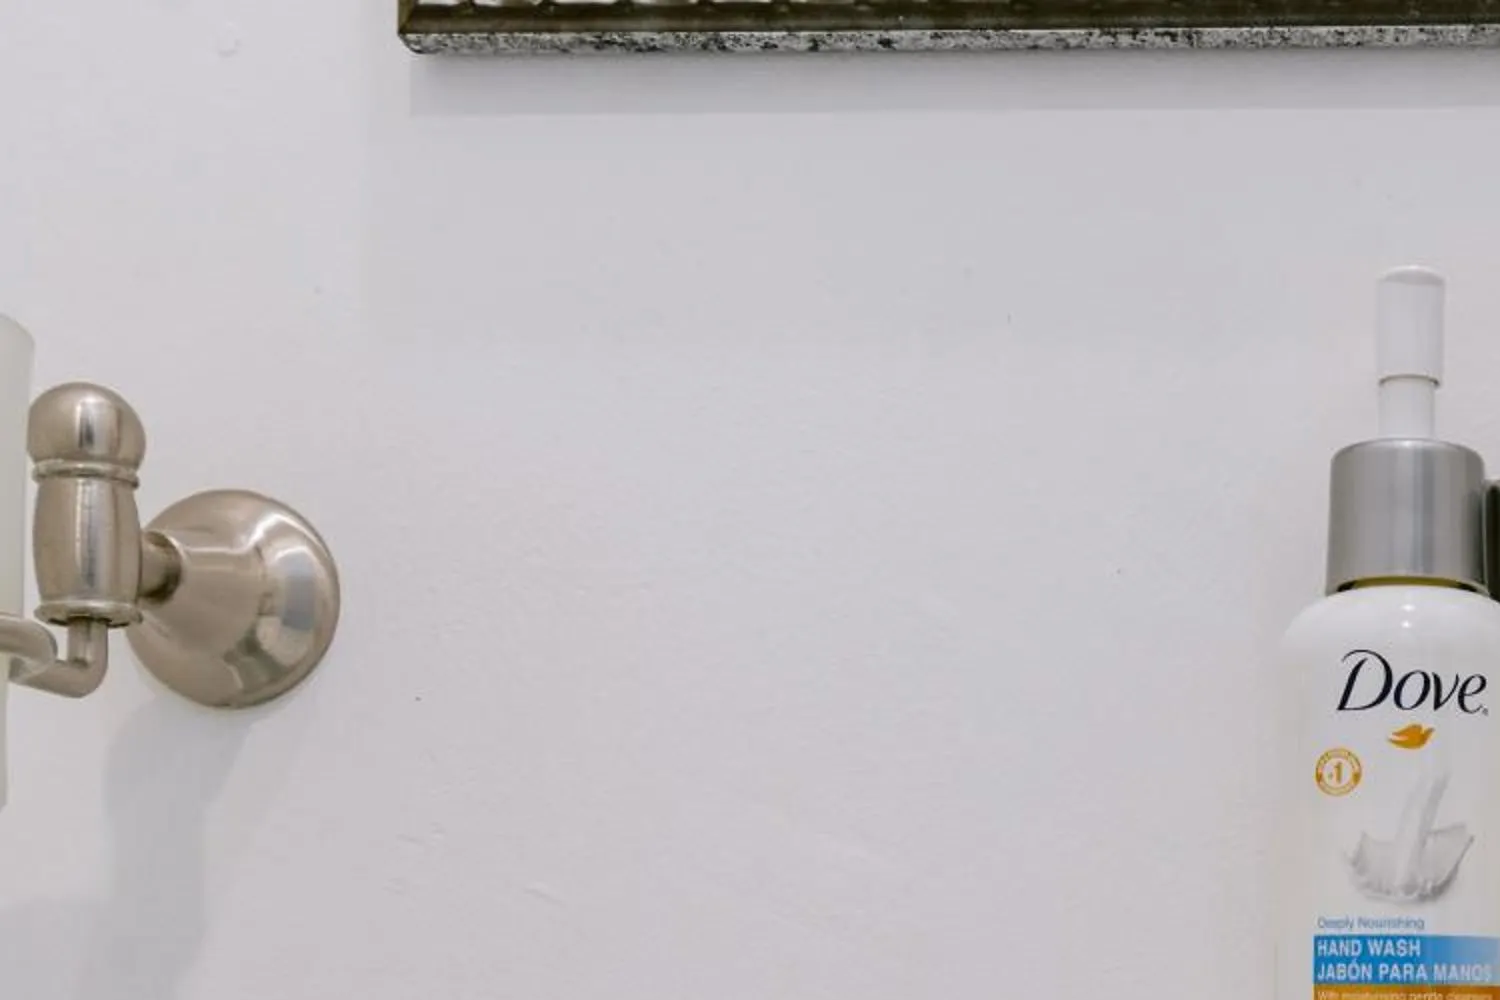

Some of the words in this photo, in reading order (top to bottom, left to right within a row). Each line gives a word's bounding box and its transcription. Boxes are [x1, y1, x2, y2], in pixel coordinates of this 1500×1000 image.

[1336, 649, 1488, 715] Dove
[1317, 916, 1354, 930] Deeply
[1358, 916, 1425, 930] Nourishing
[1317, 939, 1362, 957] HAND
[1367, 939, 1421, 957] WASH
[1317, 959, 1373, 981] JABÓN
[1379, 963, 1429, 981] PARA
[1433, 963, 1493, 982] MANOS
